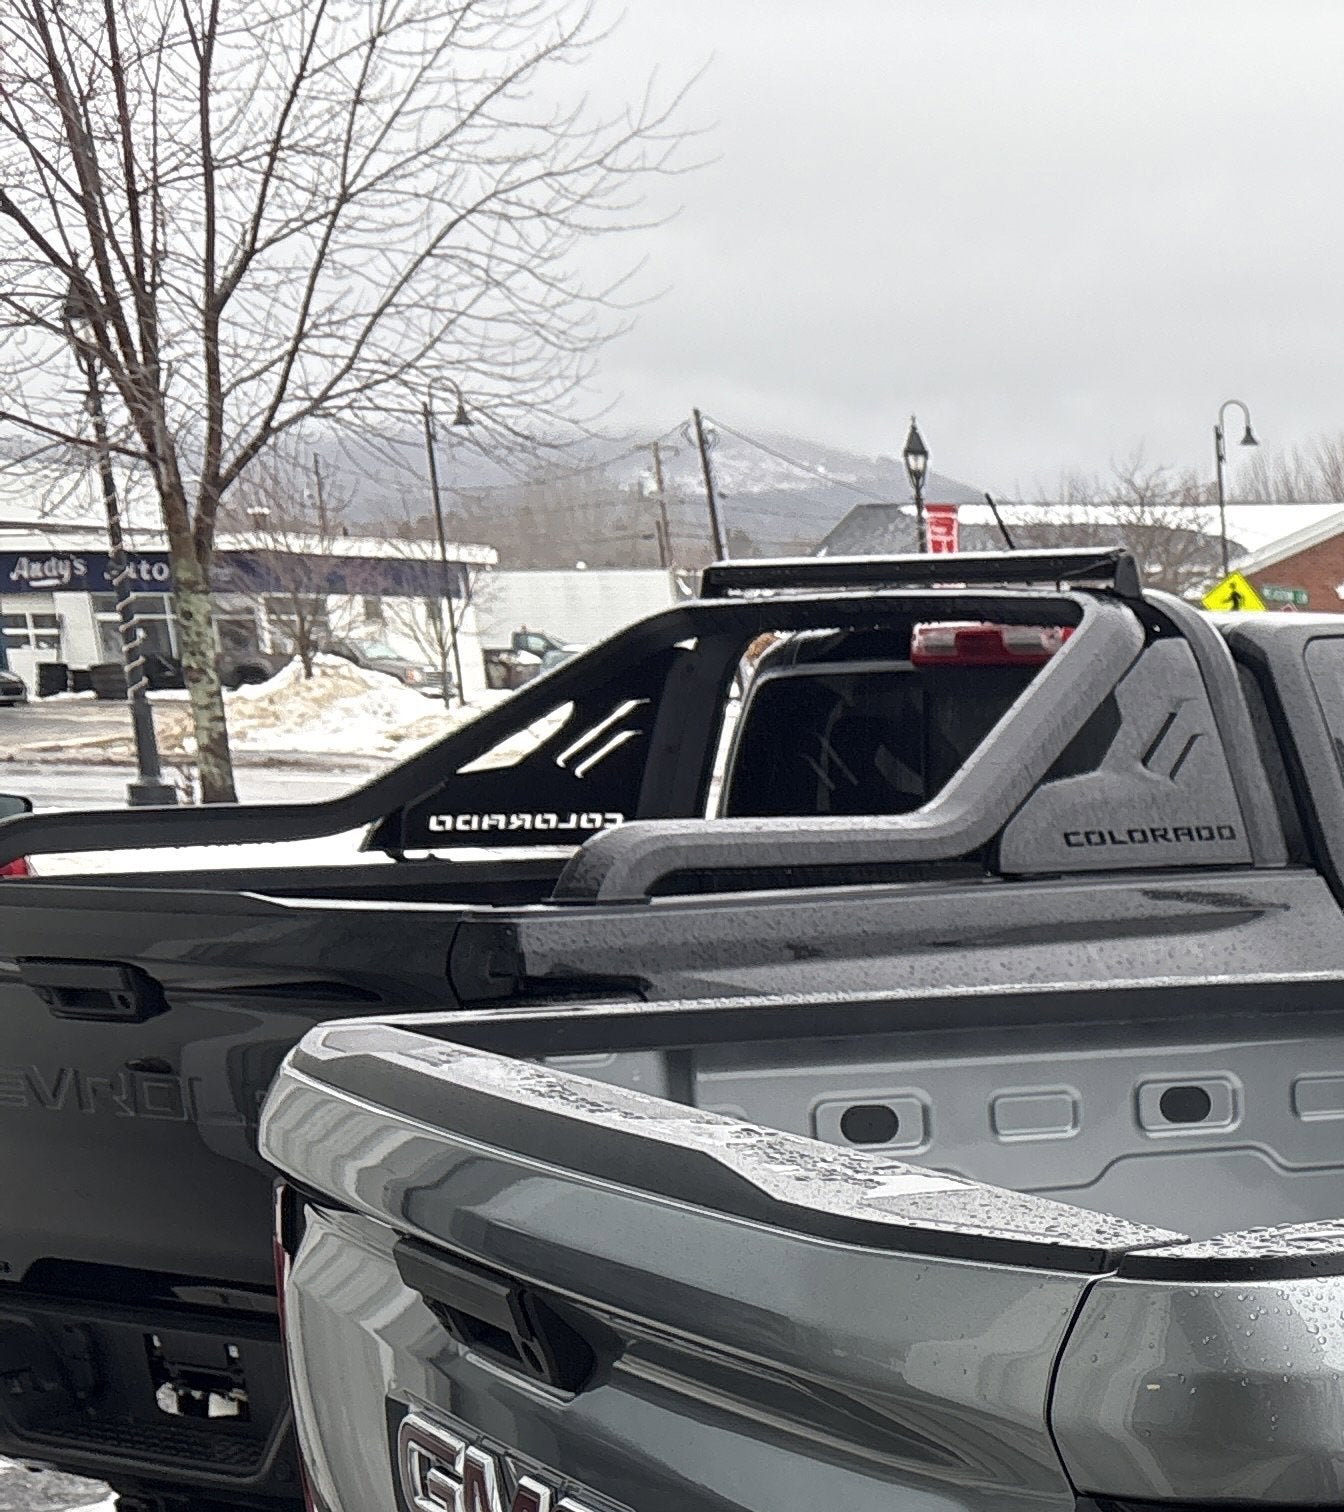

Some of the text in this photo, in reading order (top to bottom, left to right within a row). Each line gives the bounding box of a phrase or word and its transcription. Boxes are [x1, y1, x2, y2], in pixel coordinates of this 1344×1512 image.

[9, 555, 170, 584] Andy's uto
[1063, 824, 1237, 848] COLORADO
